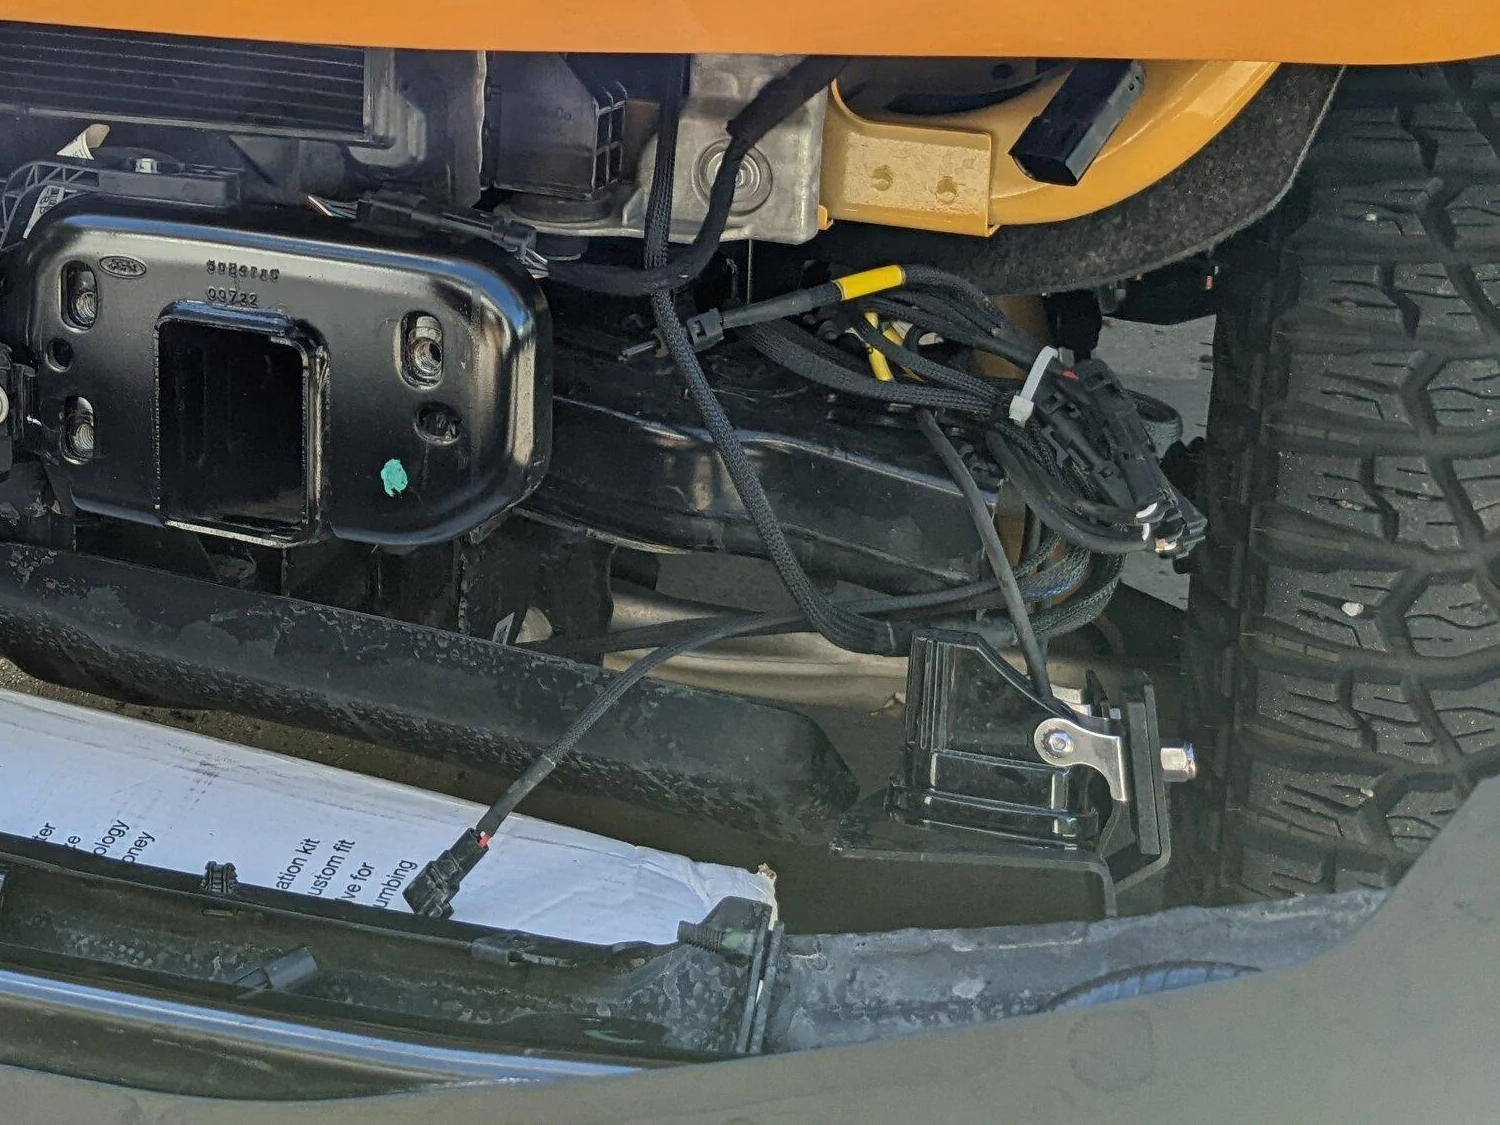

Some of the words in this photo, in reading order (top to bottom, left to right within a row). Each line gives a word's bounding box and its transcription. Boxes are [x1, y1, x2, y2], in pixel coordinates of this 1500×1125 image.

[93, 819, 131, 857] ology
[122, 831, 156, 863] oney
[276, 857, 308, 890] ation
[295, 838, 321, 856] kit
[307, 855, 345, 896] ustom
[332, 838, 356, 854] fit
[335, 883, 362, 901] ve
[349, 861, 375, 882] for
[372, 859, 419, 909] umbing
